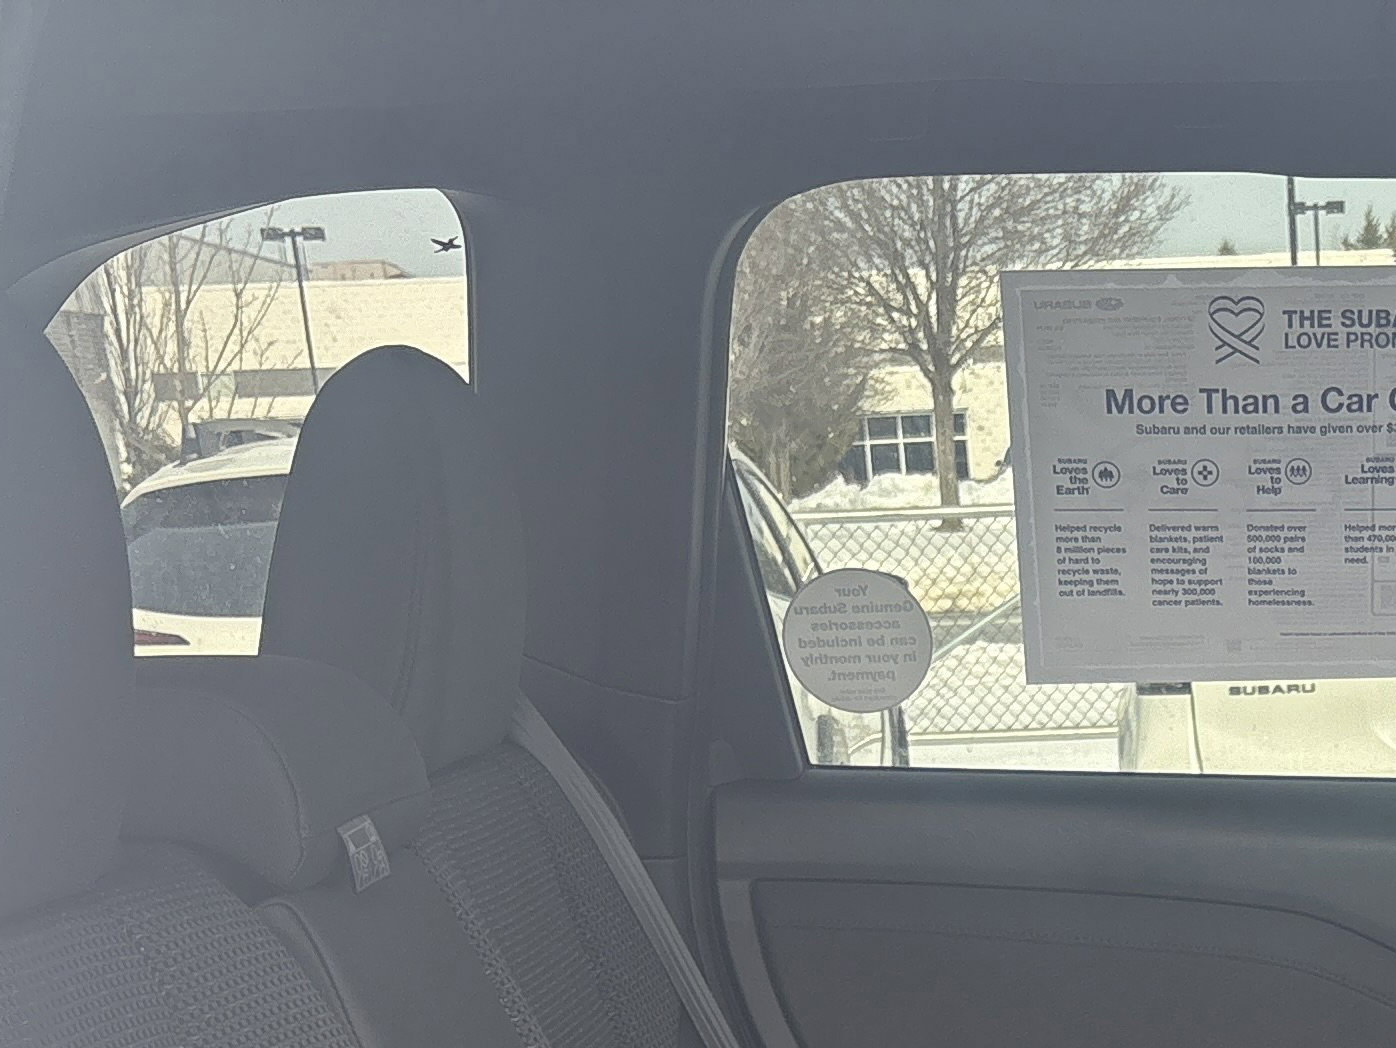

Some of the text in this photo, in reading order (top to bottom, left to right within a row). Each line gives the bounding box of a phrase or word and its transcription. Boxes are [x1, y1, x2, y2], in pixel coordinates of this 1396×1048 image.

[1283, 309, 1332, 328] THE
[1285, 332, 1339, 349] LOVE
[1105, 389, 1189, 414] More
[1199, 389, 1280, 414] Than
[1291, 394, 1309, 414] a
[1321, 386, 1379, 413] Car
[1136, 424, 1180, 435] Subaru
[1184, 424, 1206, 435] and
[1210, 427, 1230, 435] our
[1234, 424, 1283, 434] retailers
[1288, 424, 1316, 434] have
[1320, 424, 1353, 436] given
[1357, 425, 1382, 433] over
[1053, 465, 1088, 474] Loves
[1152, 466, 1187, 476] Loves
[1248, 465, 1282, 475] Loves
[1361, 464, 1395, 473] Loves
[1069, 476, 1088, 484] the
[1176, 477, 1187, 485] to
[1270, 476, 1281, 484] to
[1345, 475, 1395, 486] Learning
[1056, 485, 1088, 495] Earth
[1160, 486, 1188, 495] Care
[1257, 485, 1282, 496] Help
[1055, 524, 1122, 534] Helped recycle
[1149, 524, 1192, 532] Delivered
[1247, 524, 1284, 532] Donated
[1344, 524, 1375, 533] Helped
[1081, 535, 1101, 543] than
[1150, 535, 1224, 544] blankets, patient
[1283, 535, 1306, 543] pairs
[1097, 547, 1127, 555] pieces
[1172, 546, 1191, 554] kits,
[1151, 557, 1206, 566] encouraging
[1344, 556, 1368, 564] need.
[1058, 568, 1090, 576] recycle
[1151, 568, 1196, 576] messages
[1058, 578, 1094, 587] keeping
[1151, 578, 1173, 586] hope
[1188, 578, 1223, 586] support
[1152, 588, 1179, 596] nearly
[1248, 588, 1305, 597] experiencing
[1185, 598, 1223, 607] patients.
[1229, 683, 1316, 696] SUBARU
